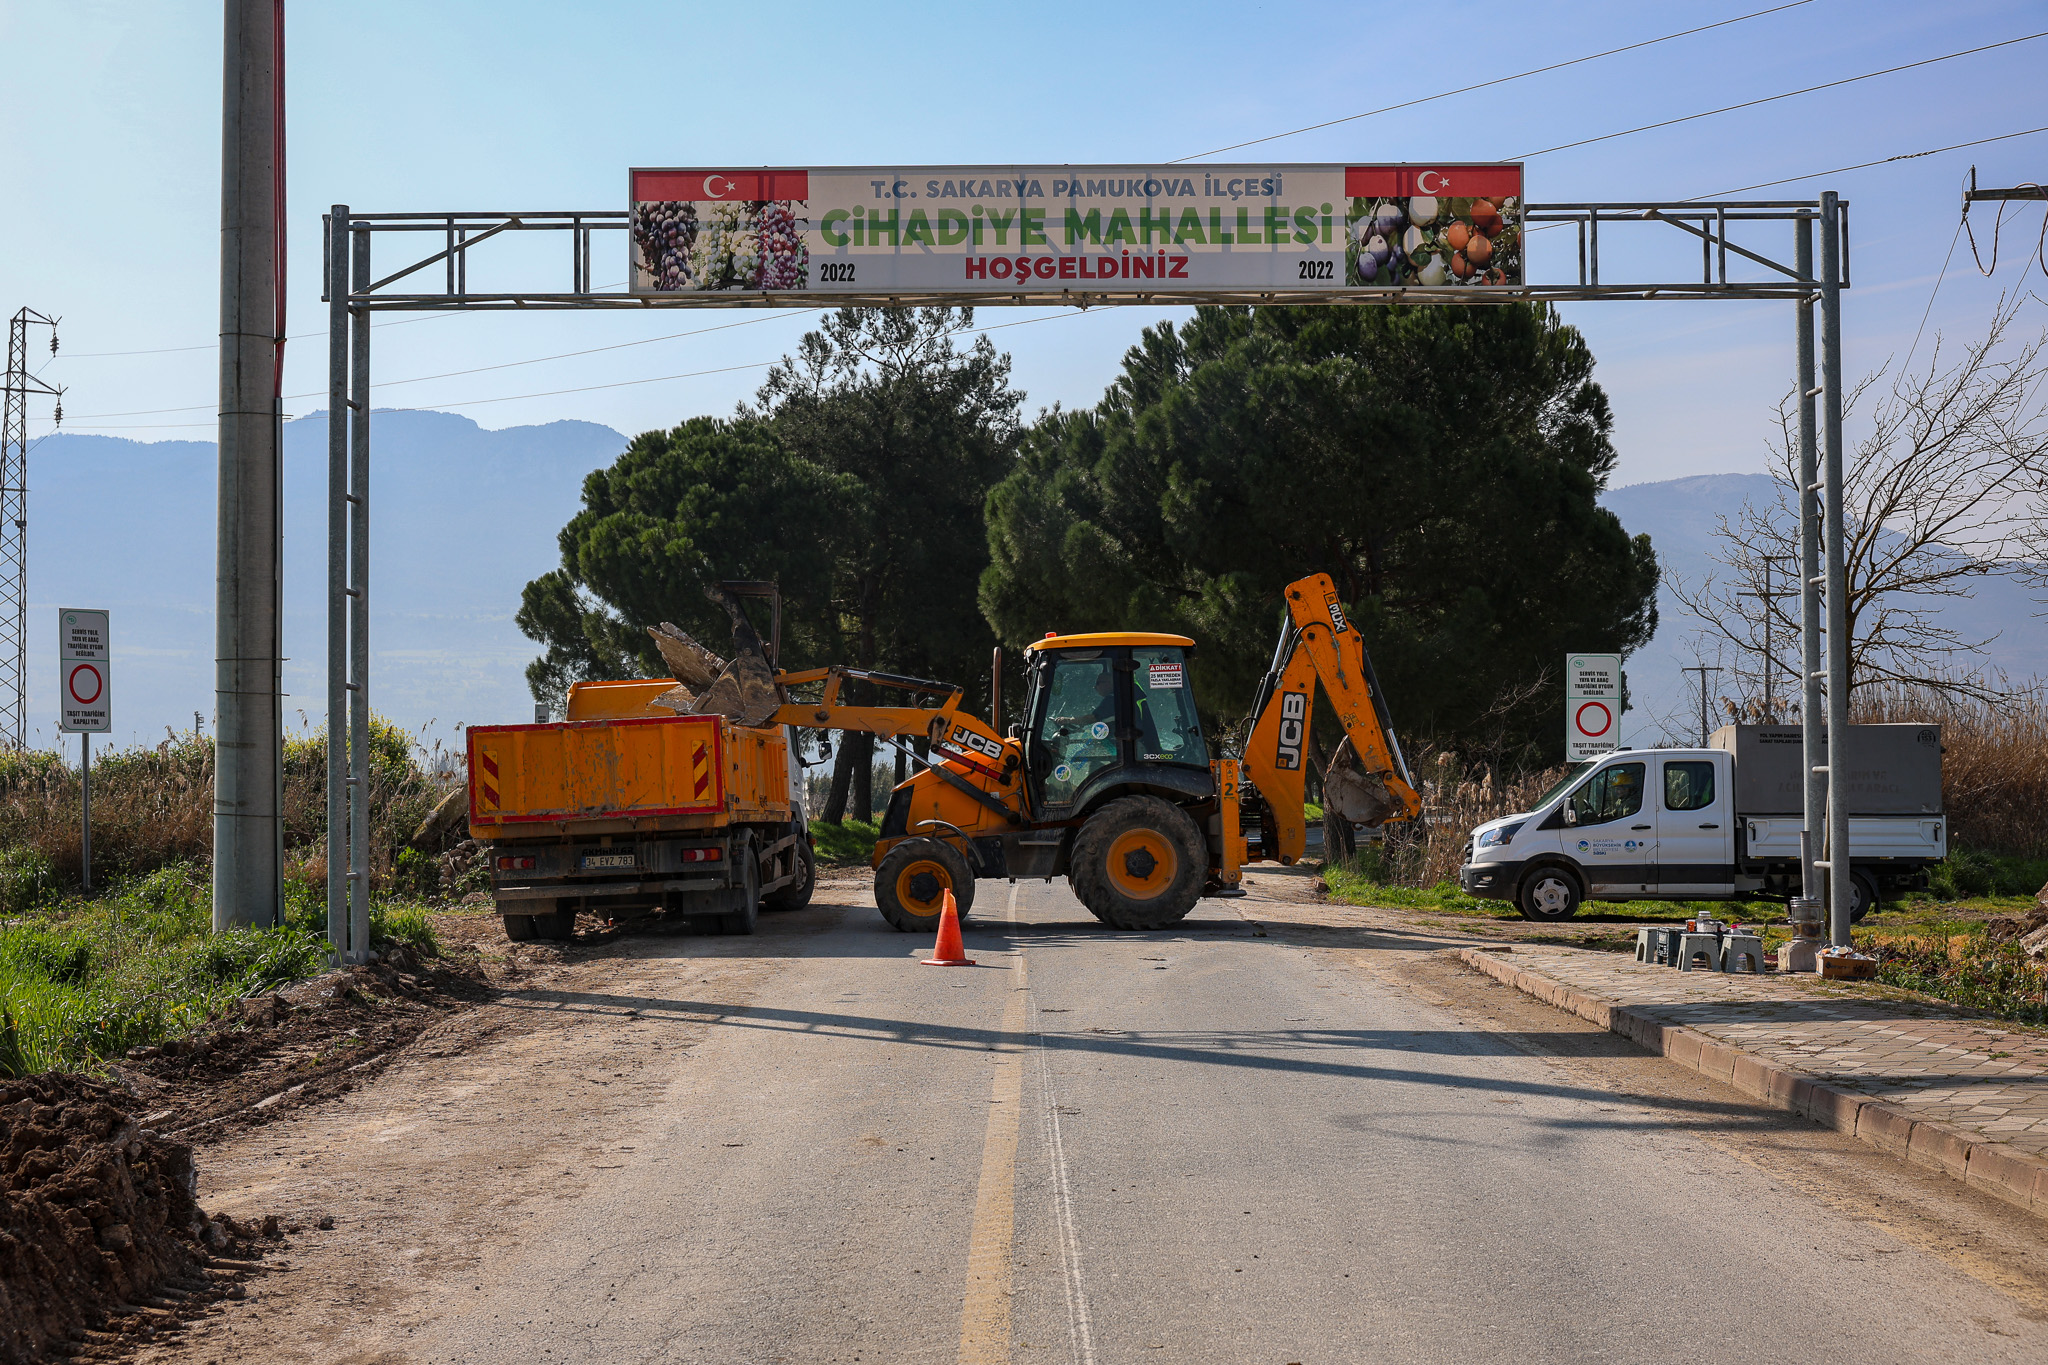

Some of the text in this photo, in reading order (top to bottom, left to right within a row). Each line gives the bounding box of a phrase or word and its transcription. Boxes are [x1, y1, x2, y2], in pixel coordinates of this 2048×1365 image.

[871, 172, 1283, 201] T.C. SAKARYA PAMUKOVA İLÇESİ
[820, 263, 856, 282] 2022
[965, 248, 1189, 286] HOŞGELDİNİZ
[1298, 260, 1334, 280] 2022
[68, 642, 88, 650] TRAFİĞİNE
[67, 710, 105, 718] TAŞIT TRAFİĞİNE
[73, 718, 90, 726] KAPALI
[1280, 693, 1304, 769] JCB
[953, 730, 1002, 759] JCB
[1588, 741, 1614, 749] TRAFİĞİNE
[1224, 782, 1234, 796] 2
[586, 857, 596, 867] 34
[618, 856, 633, 866] 783
